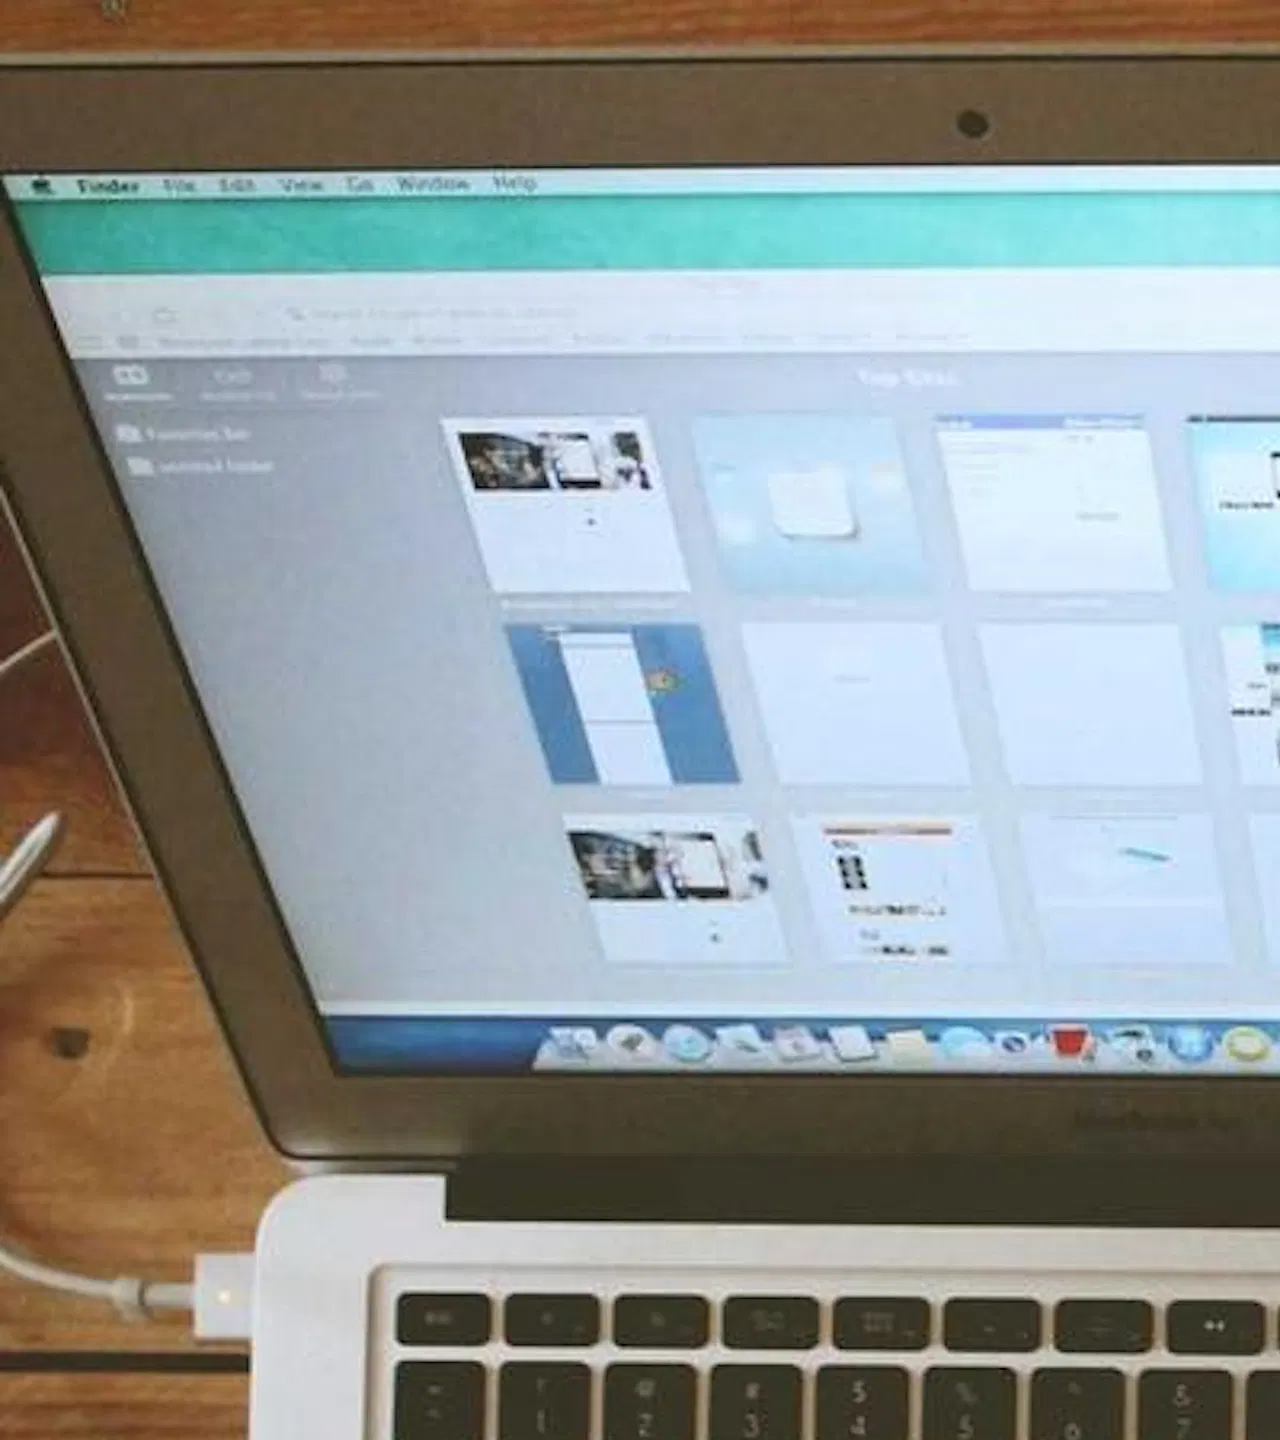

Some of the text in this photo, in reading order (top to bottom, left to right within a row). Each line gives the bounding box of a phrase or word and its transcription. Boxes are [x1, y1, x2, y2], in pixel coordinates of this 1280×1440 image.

[75, 178, 141, 195] Finder
[277, 177, 323, 193] View
[397, 174, 471, 192] Window
[491, 172, 539, 192] Help
